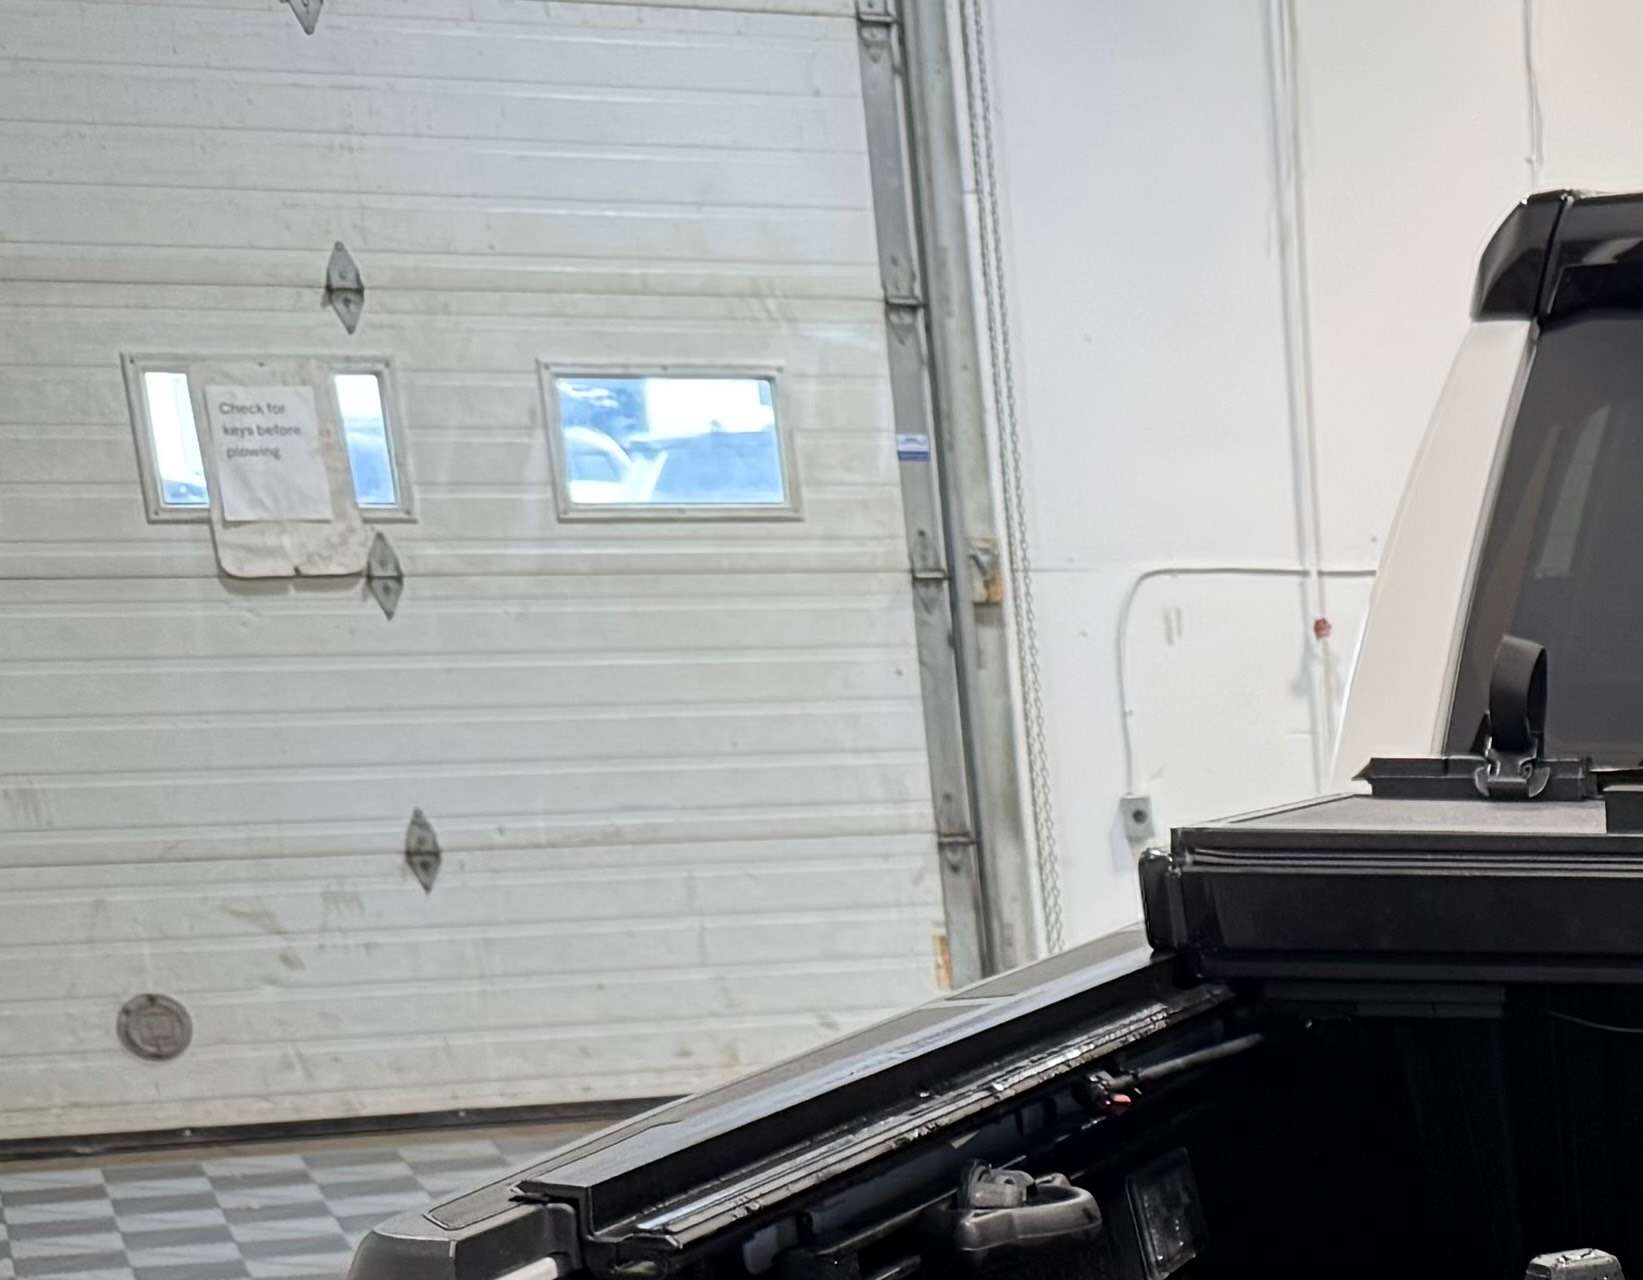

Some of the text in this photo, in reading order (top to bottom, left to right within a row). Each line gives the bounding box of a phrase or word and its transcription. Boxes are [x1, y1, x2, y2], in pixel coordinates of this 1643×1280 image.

[218, 402, 286, 415] Check for
[222, 424, 301, 438] keys before
